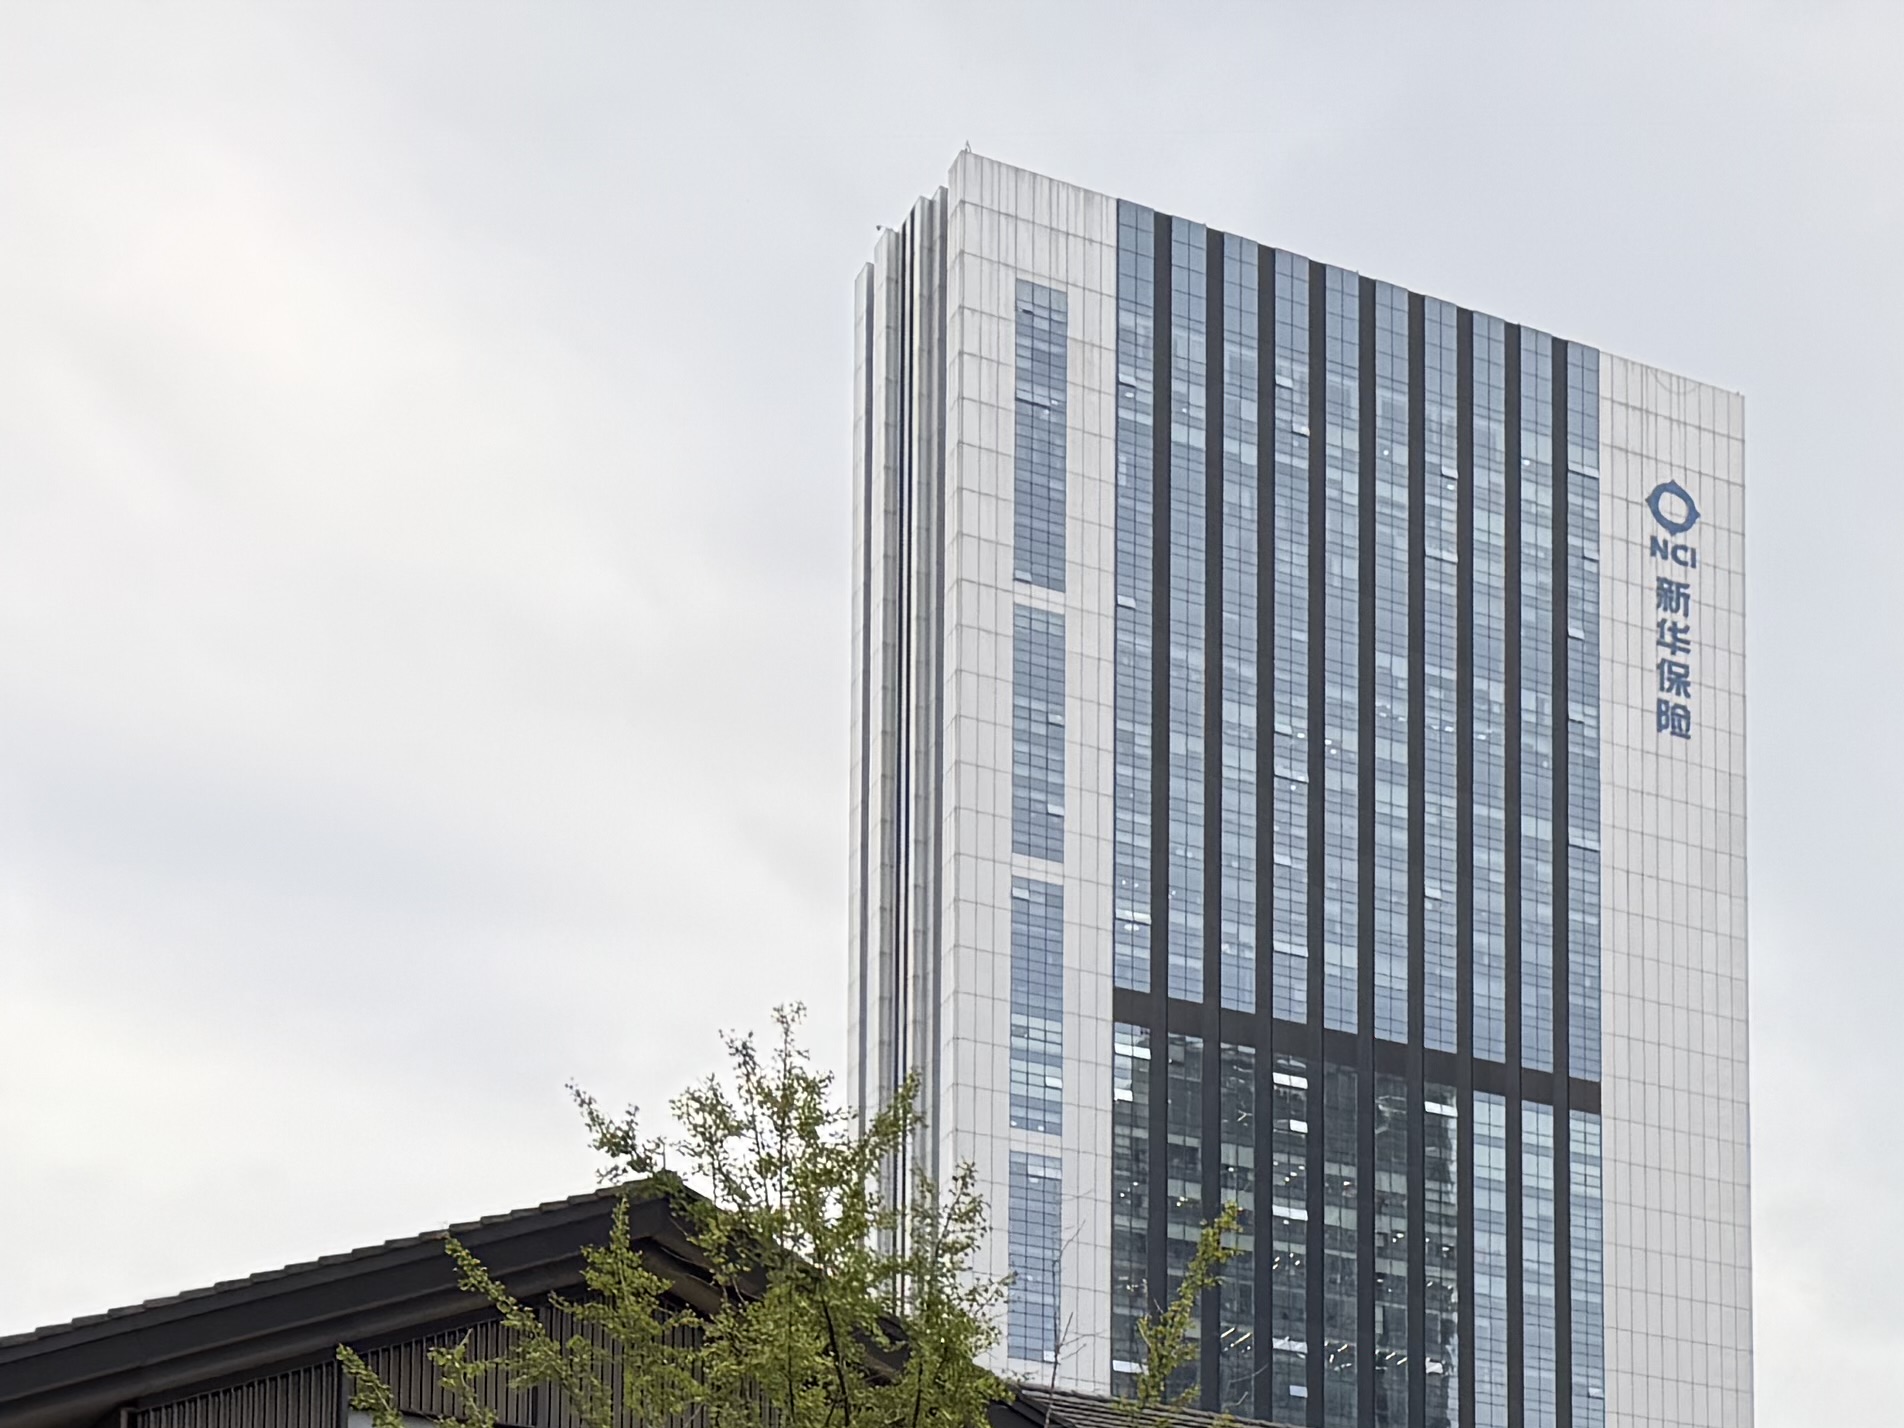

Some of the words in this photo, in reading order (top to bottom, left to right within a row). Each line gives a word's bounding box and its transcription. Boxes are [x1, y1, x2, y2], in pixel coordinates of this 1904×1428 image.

[1649, 534, 1697, 569] NCI
[1656, 575, 1692, 740] 新华保险
